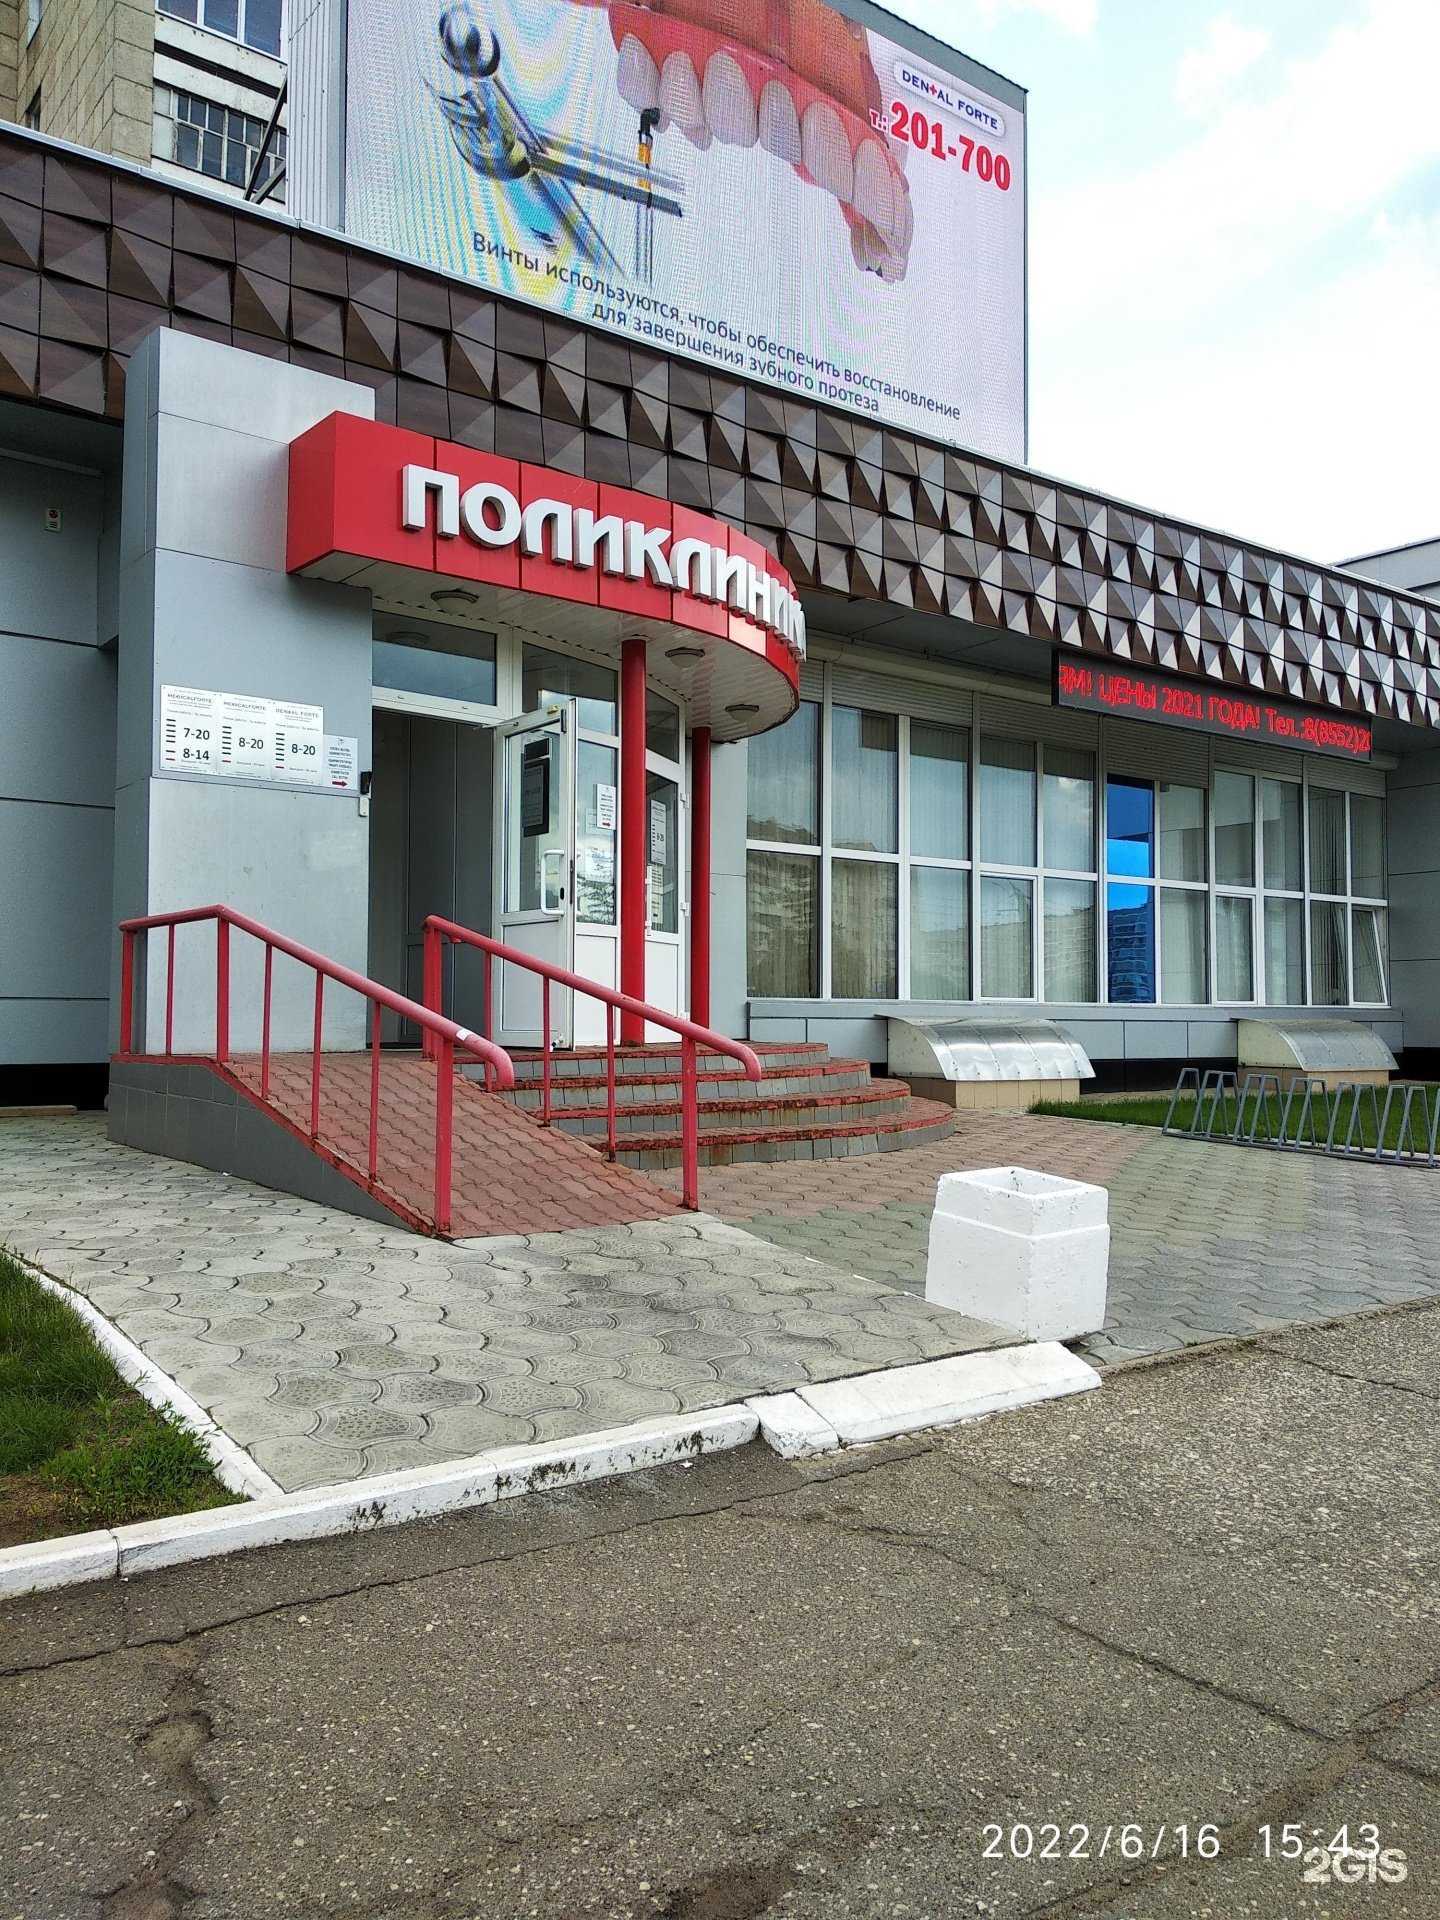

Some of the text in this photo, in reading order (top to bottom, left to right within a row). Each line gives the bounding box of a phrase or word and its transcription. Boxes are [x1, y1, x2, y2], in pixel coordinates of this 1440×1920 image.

[957, 100, 998, 130] FORTE
[891, 101, 1011, 191] 201-700
[473, 231, 961, 421] Винты используются, чтобы обеспечить восстановление
[592, 304, 879, 413] для завершения зубного протеза
[1098, 673, 1156, 709] ЦЕНЫ
[1162, 686, 1203, 720] 2021
[1208, 696, 1260, 731] ГОДА!
[183, 727, 210, 741] 7-20
[238, 737, 264, 750] 8-20
[182, 748, 210, 761] 8-14
[291, 743, 316, 756] 8-20
